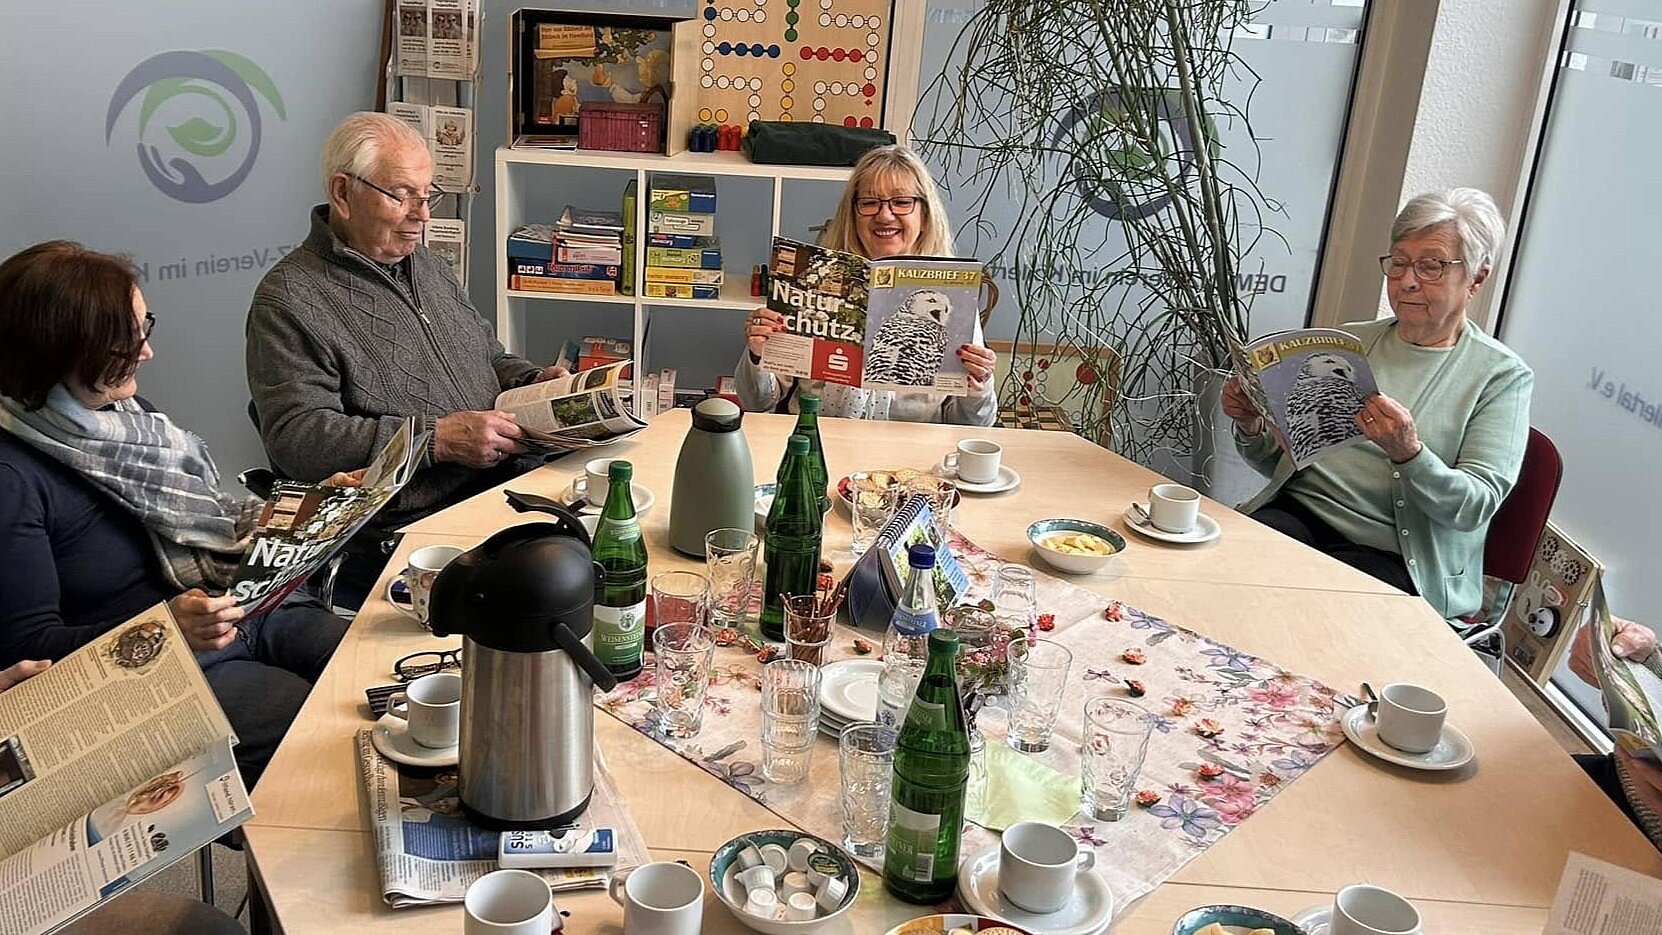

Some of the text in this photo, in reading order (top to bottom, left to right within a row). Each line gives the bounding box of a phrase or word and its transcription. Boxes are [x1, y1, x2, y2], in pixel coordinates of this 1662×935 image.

[897, 268, 978, 280] KAUZBRIEF 37
[783, 310, 856, 340] chutz
